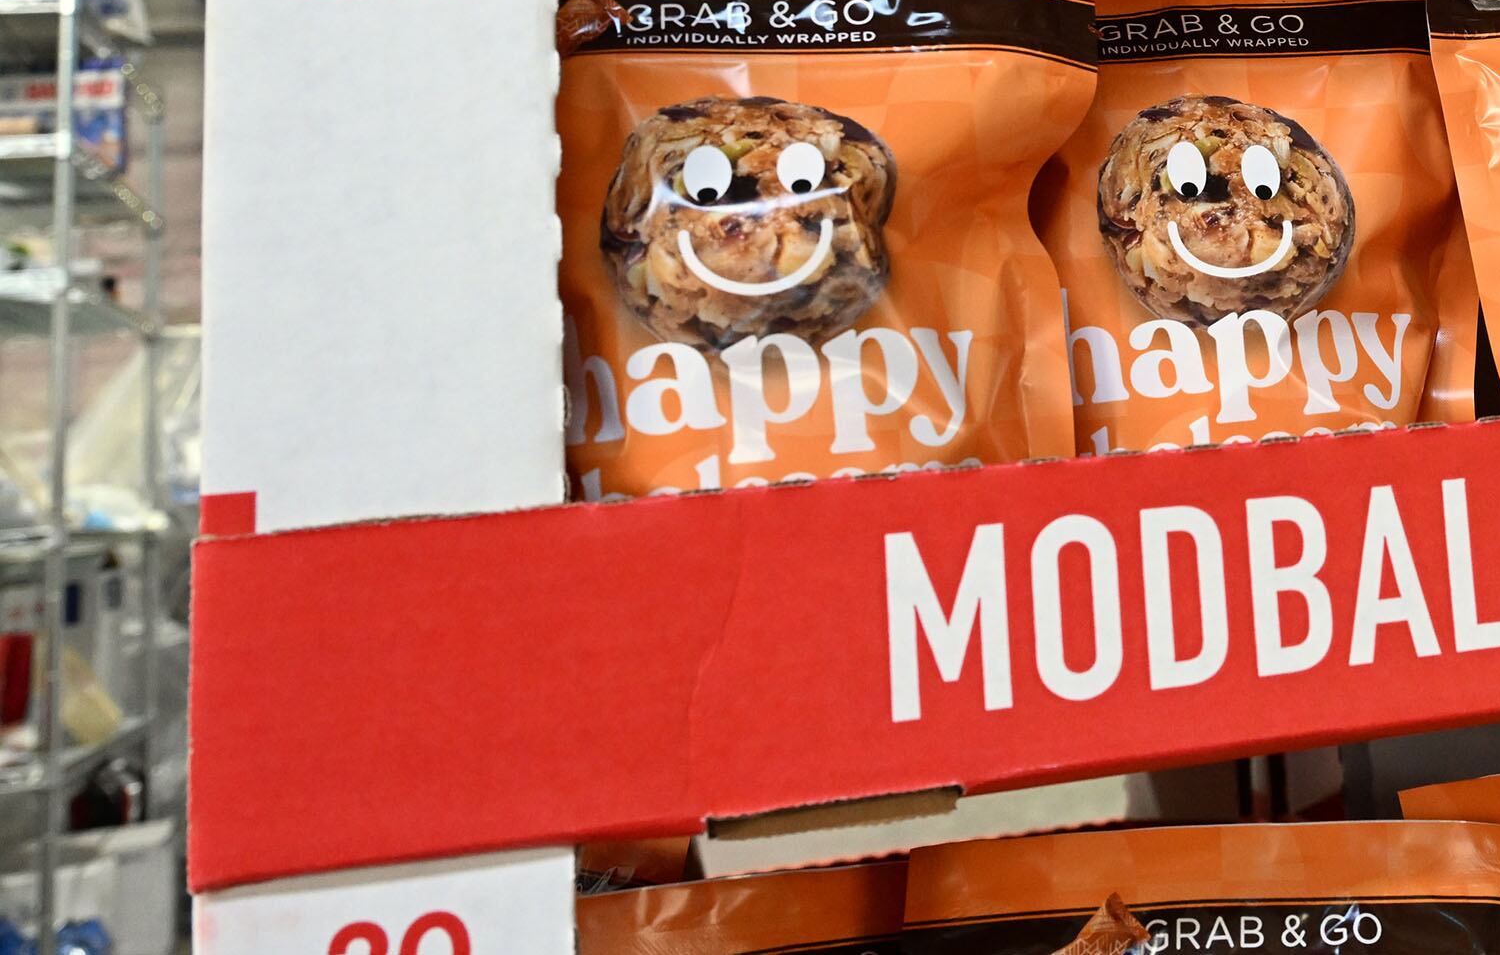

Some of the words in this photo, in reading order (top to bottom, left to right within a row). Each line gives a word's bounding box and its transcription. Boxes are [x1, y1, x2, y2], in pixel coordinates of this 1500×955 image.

[626, 1, 753, 32] GRAB
[768, 0, 797, 29] &
[1099, 13, 1205, 42] GRAB
[1217, 13, 1241, 35] &
[1249, 13, 1305, 34] GO
[626, 33, 770, 45] INDIVIDUALLY
[776, 30, 878, 45] WRAPPED
[1101, 37, 1221, 56] INDIVIDUALLY
[1225, 37, 1310, 48] WRAPPED
[1059, 286, 1412, 424] happy
[563, 314, 974, 465] happy
[1143, 915, 1266, 953] GRAB
[1281, 914, 1308, 950] &
[1319, 912, 1383, 946] GO
